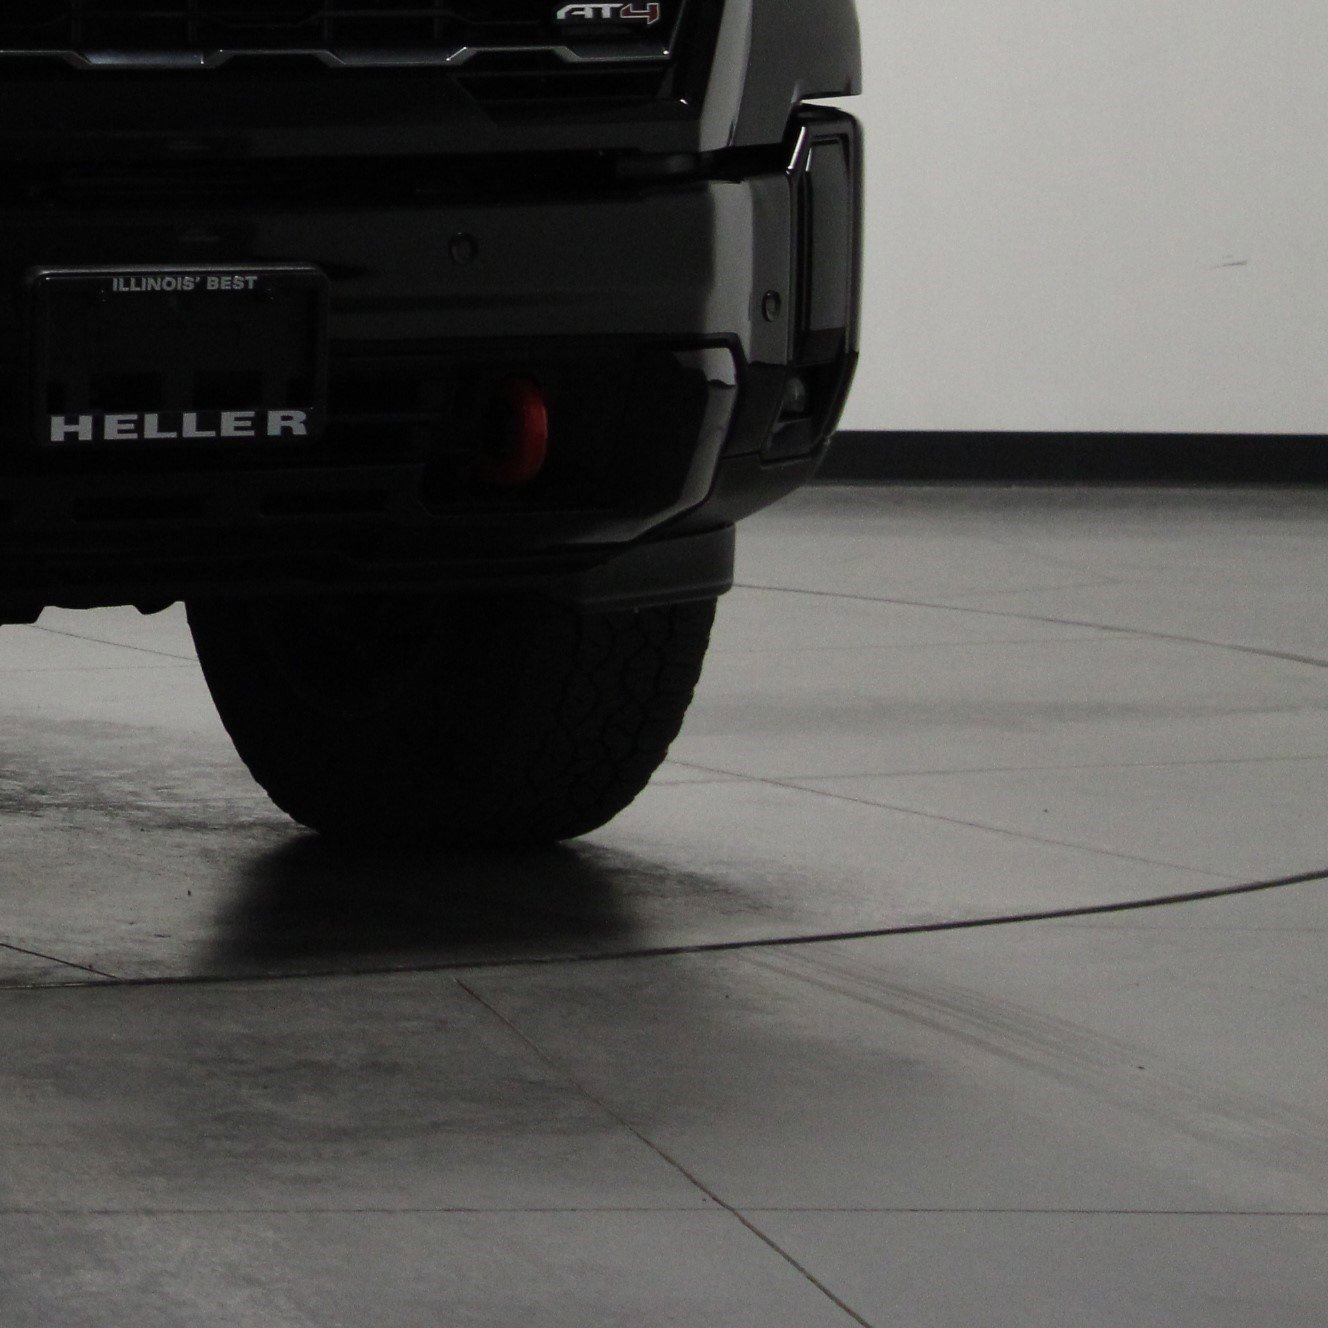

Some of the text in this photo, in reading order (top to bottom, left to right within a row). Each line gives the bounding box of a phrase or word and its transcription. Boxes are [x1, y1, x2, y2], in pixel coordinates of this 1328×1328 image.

[557, 3, 660, 24] AT4
[112, 276, 258, 292] ILLINOIS' BEST
[50, 410, 307, 442] HELLER
